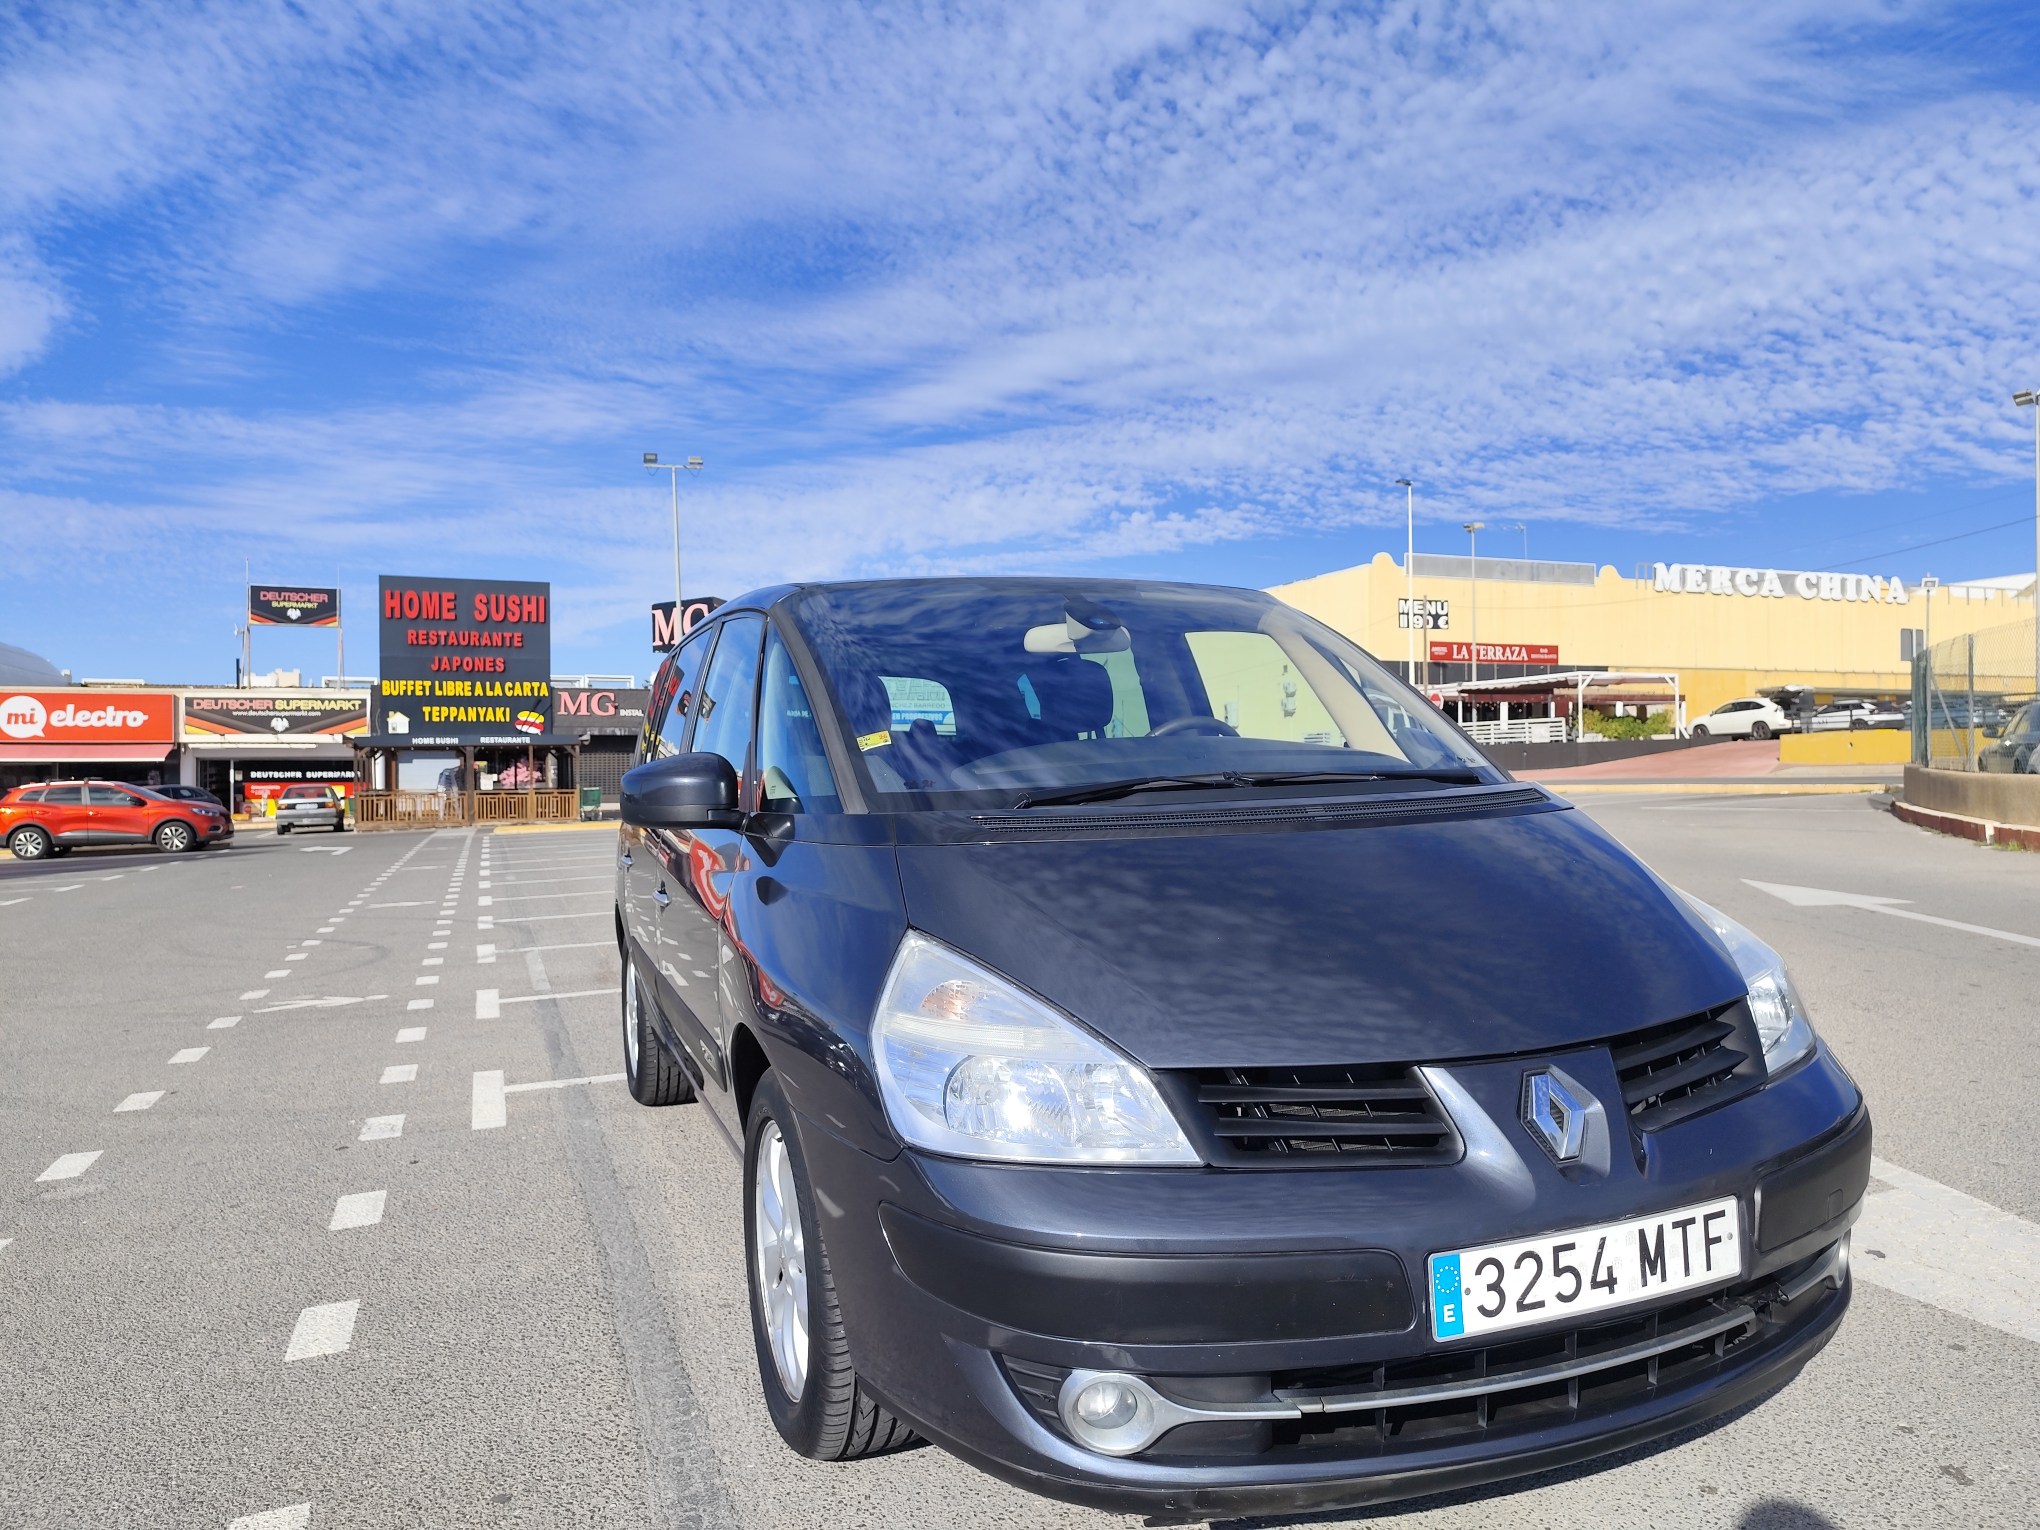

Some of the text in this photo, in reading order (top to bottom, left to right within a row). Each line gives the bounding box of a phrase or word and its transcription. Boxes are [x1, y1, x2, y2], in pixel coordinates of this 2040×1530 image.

[1653, 561, 1909, 604] MERCA CHINA
[259, 591, 328, 603] DEUTSCHER
[271, 601, 318, 609] SUPERMARKT
[384, 589, 547, 624] HOME SUSHI
[1398, 599, 1449, 615] MENU
[407, 629, 524, 648] RESTAURANTE
[1452, 644, 1528, 661] LA TERRAZA
[431, 655, 506, 673] JAPONES
[381, 680, 549, 697] BUFFET LIBRE A LA CARTA
[193, 699, 362, 711] DEUTSCHER SUPERMARKT
[557, 691, 619, 717] MG
[6, 707, 38, 725] mi
[49, 703, 149, 728] electro
[422, 706, 511, 722] TEPPANYAKI
[412, 736, 531, 745] HOME SUSHI RESTAURANTE
[250, 771, 303, 779] DEUTSCHER
[1473, 1209, 1727, 1318] 3254 MTF
[1443, 1303, 1456, 1323] E
